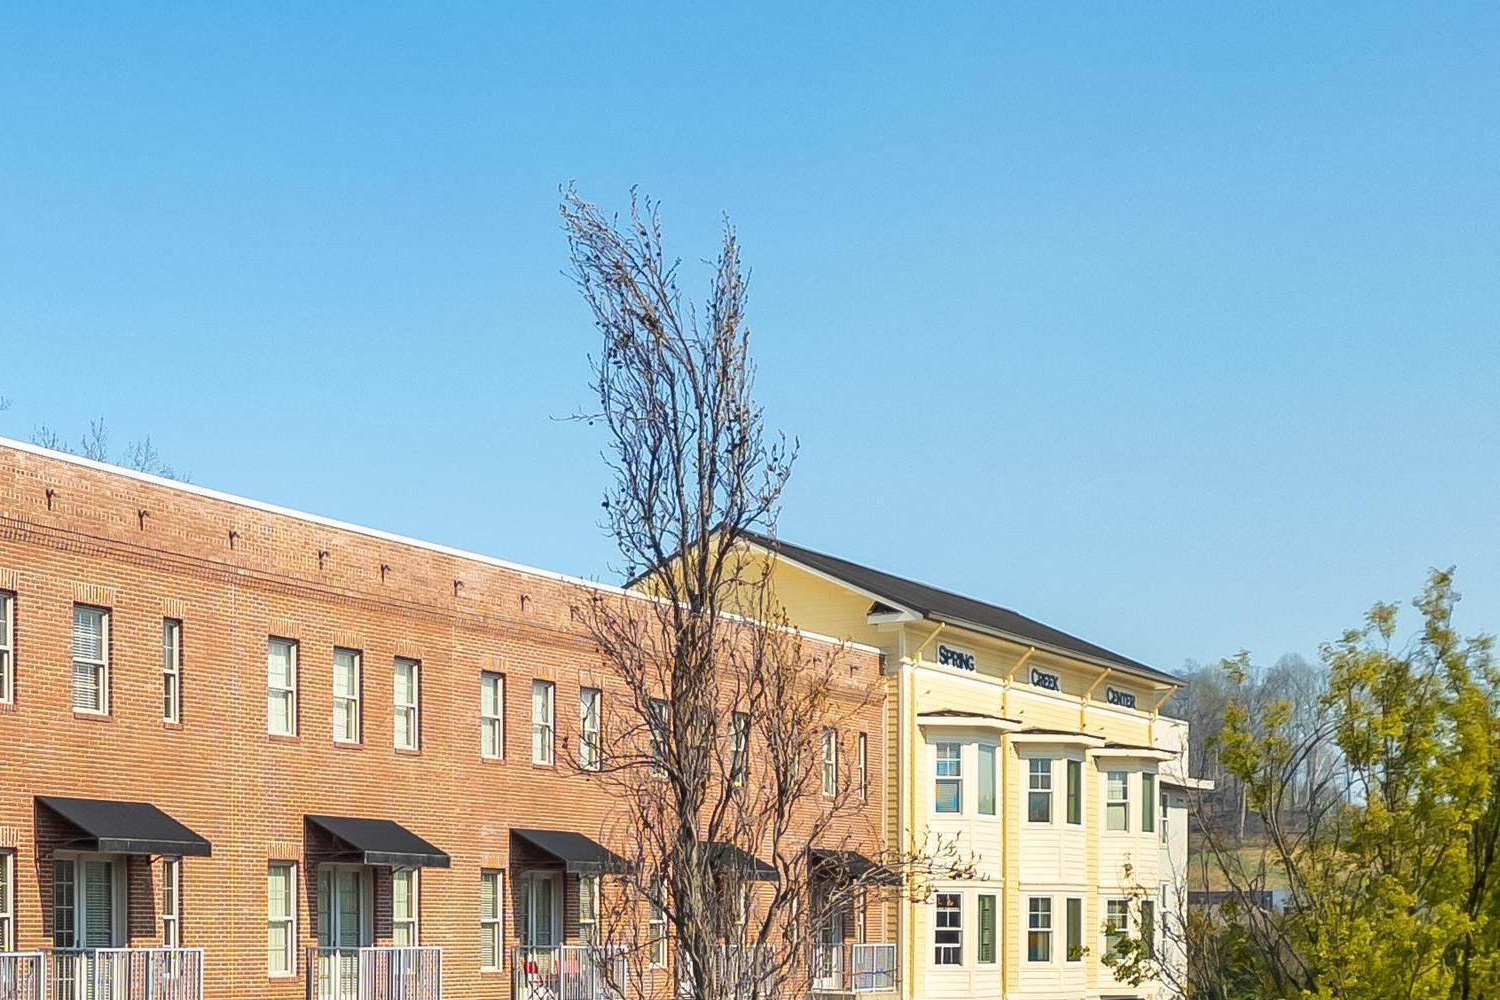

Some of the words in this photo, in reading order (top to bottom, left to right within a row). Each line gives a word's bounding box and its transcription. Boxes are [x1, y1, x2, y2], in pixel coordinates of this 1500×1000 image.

[938, 645, 975, 672] SPRING
[1031, 668, 1060, 692] CREEK
[1106, 687, 1136, 710] CENTER
